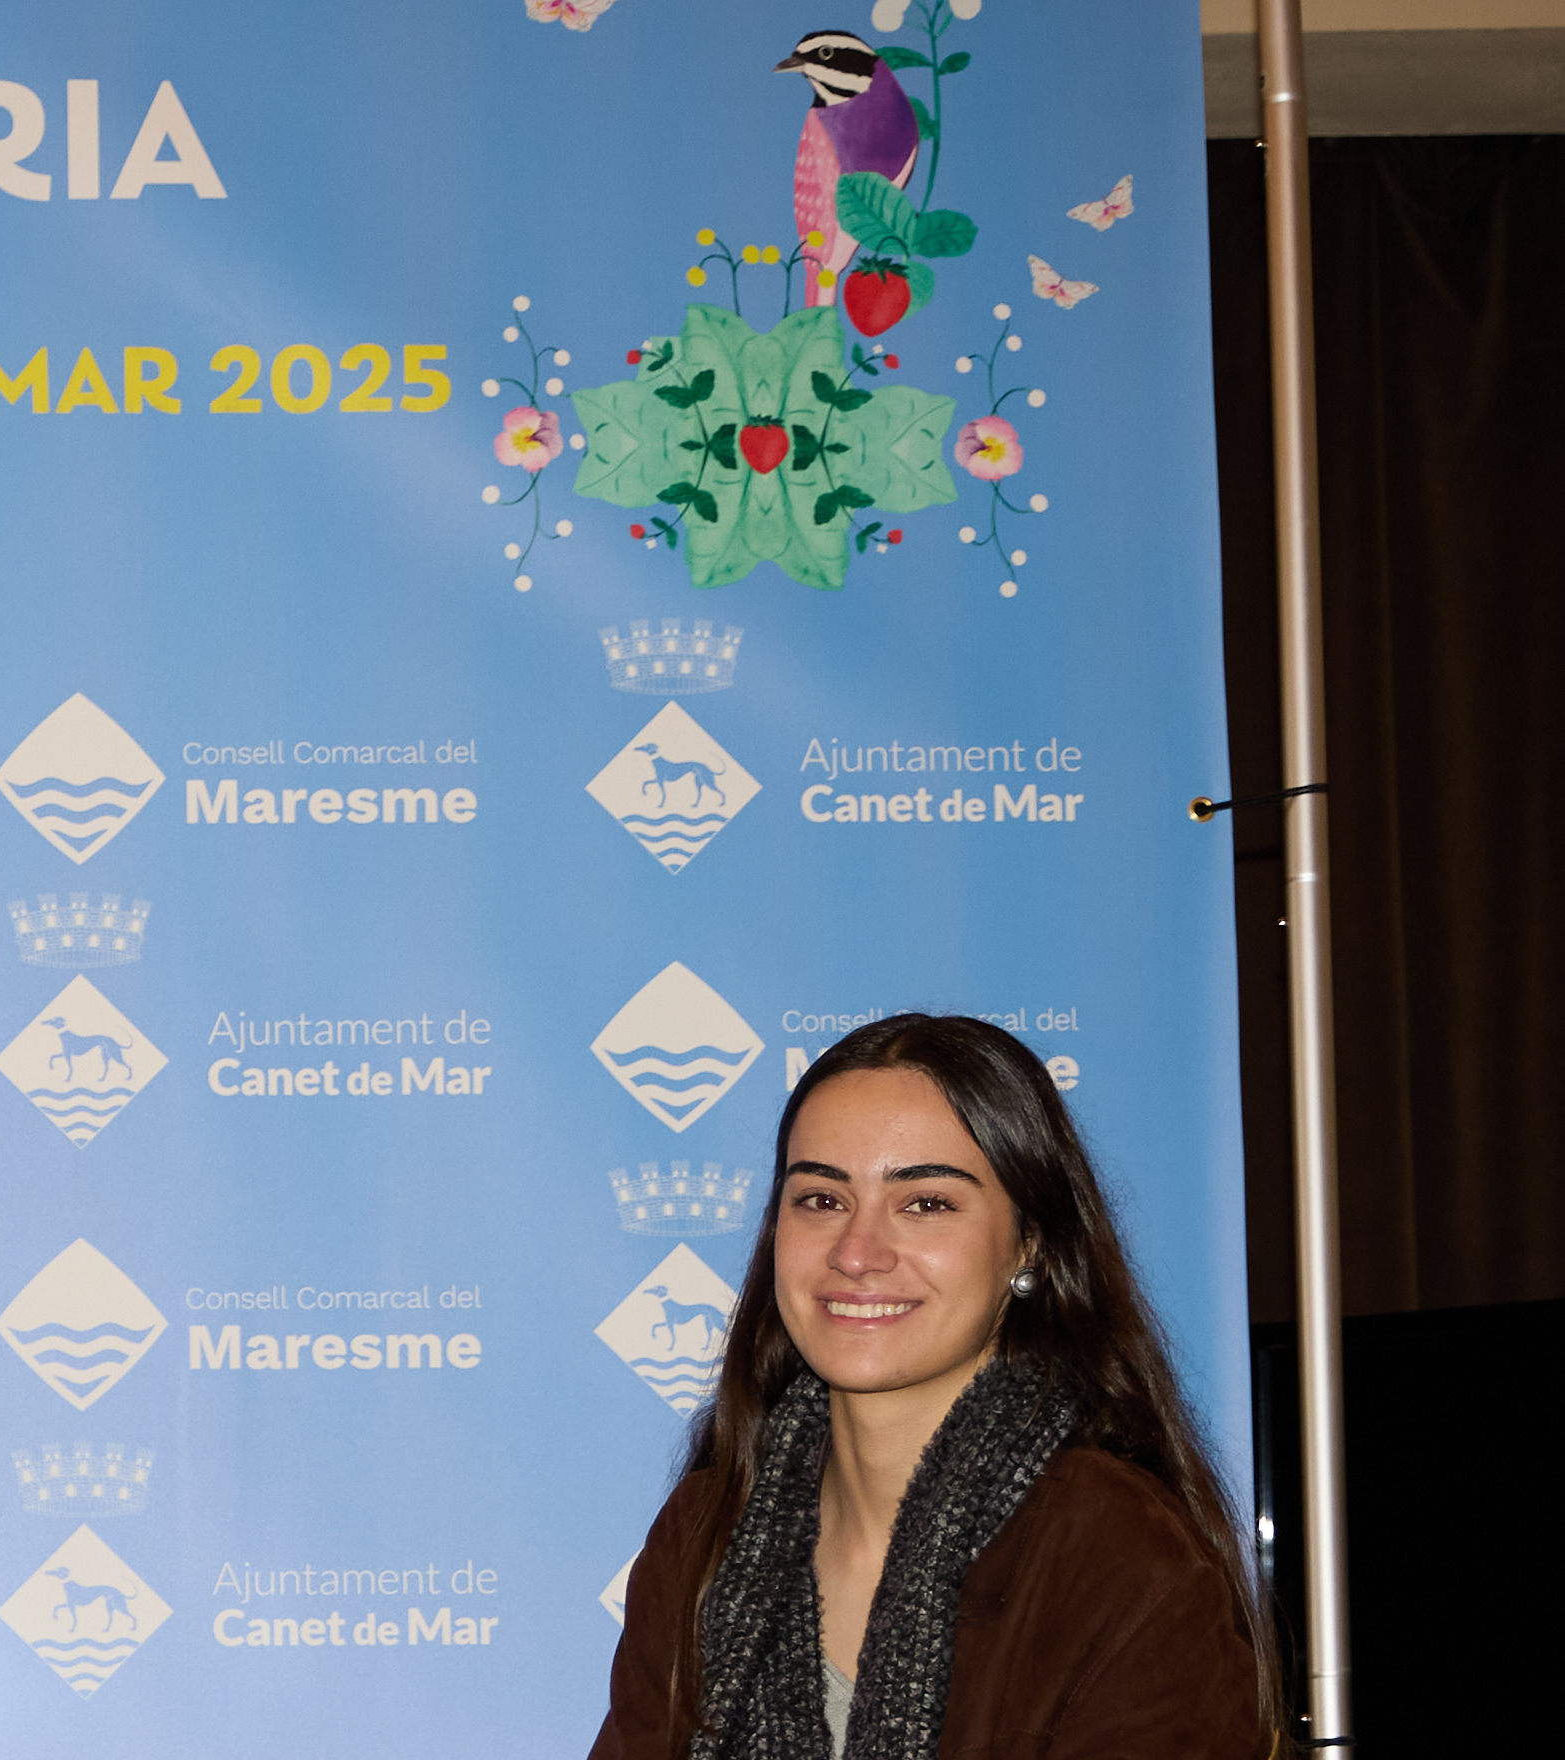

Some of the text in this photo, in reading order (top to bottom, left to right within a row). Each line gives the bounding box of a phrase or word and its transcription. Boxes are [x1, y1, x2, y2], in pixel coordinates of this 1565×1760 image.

[208, 343, 452, 414] 2025
[800, 737, 1082, 780] Ajuntament de
[800, 783, 1085, 823] Canet de Mar
[208, 1009, 491, 1054] Ajuntament de
[207, 1056, 493, 1097] Canet de Mar
[213, 1559, 498, 1603] Ajuntament de
[212, 1606, 500, 1647] Canet de Mar
